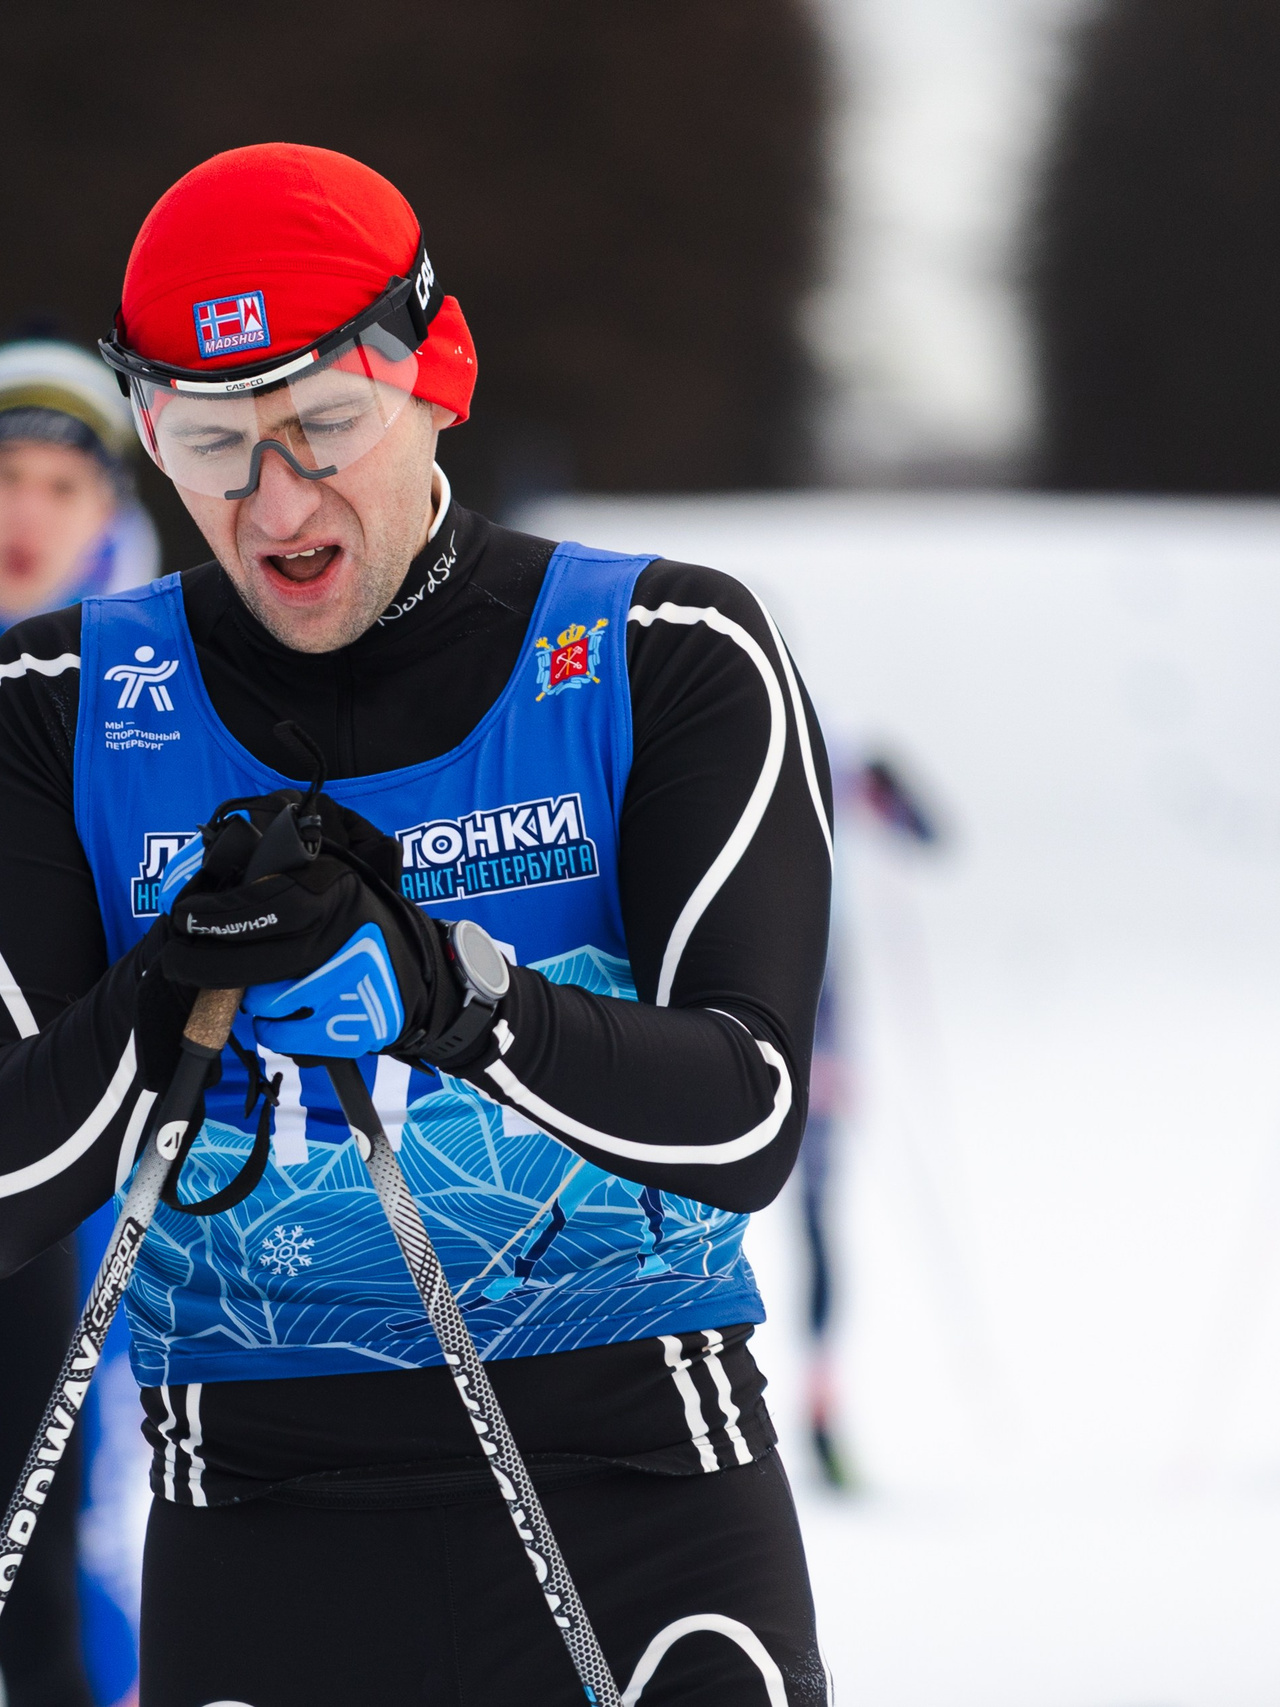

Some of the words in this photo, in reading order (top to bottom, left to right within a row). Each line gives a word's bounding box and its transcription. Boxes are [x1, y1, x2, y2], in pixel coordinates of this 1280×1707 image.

[205, 331, 265, 353] MADSHUS
[105, 721, 124, 729] МЫ
[105, 729, 180, 741] СПОРТИВНЫЙ
[105, 739, 164, 750] ПЕТЕРБУРГ
[402, 801, 580, 868] ГОНКИ
[401, 844, 593, 900] АНКТ-ПЕТЕРБУРГА
[91, 1222, 137, 1327] CARBON
